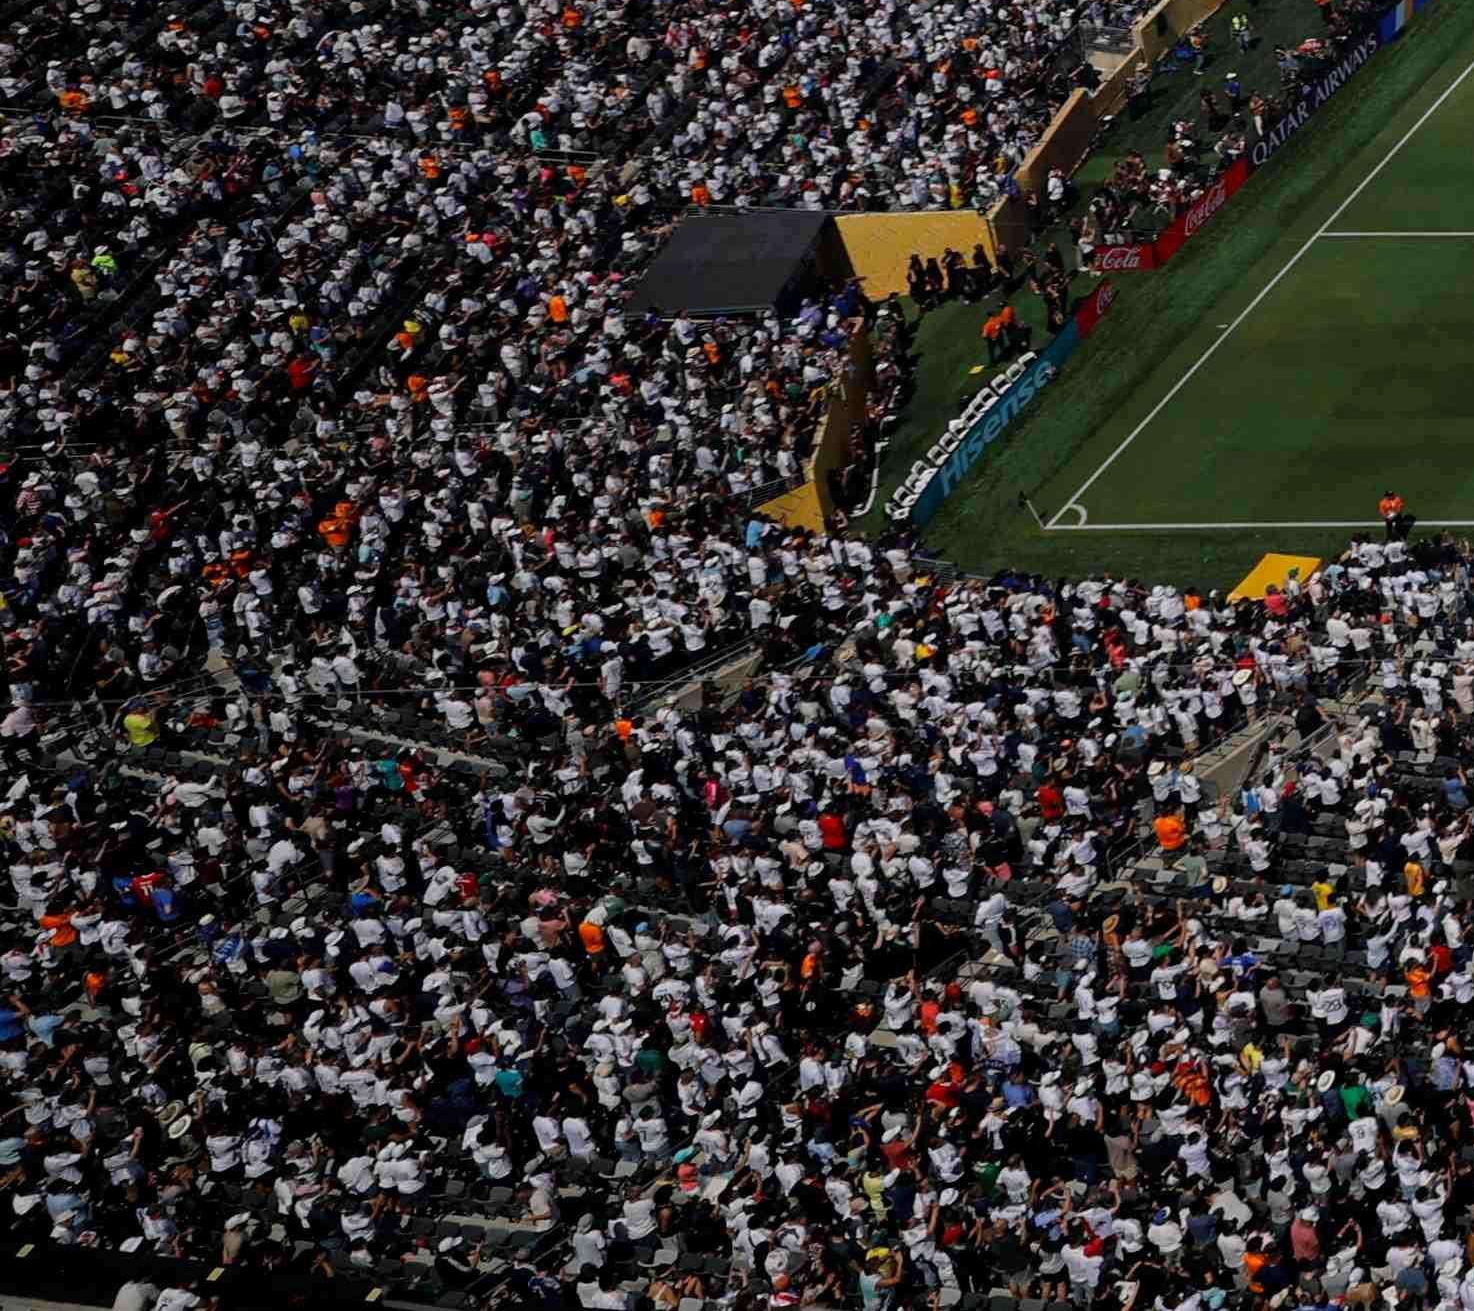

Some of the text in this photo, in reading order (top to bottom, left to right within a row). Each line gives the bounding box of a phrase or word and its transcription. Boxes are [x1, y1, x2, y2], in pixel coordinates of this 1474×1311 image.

[1252, 34, 1379, 166] QATAR AIRWAYS
[939, 359, 1053, 497] Hisense
